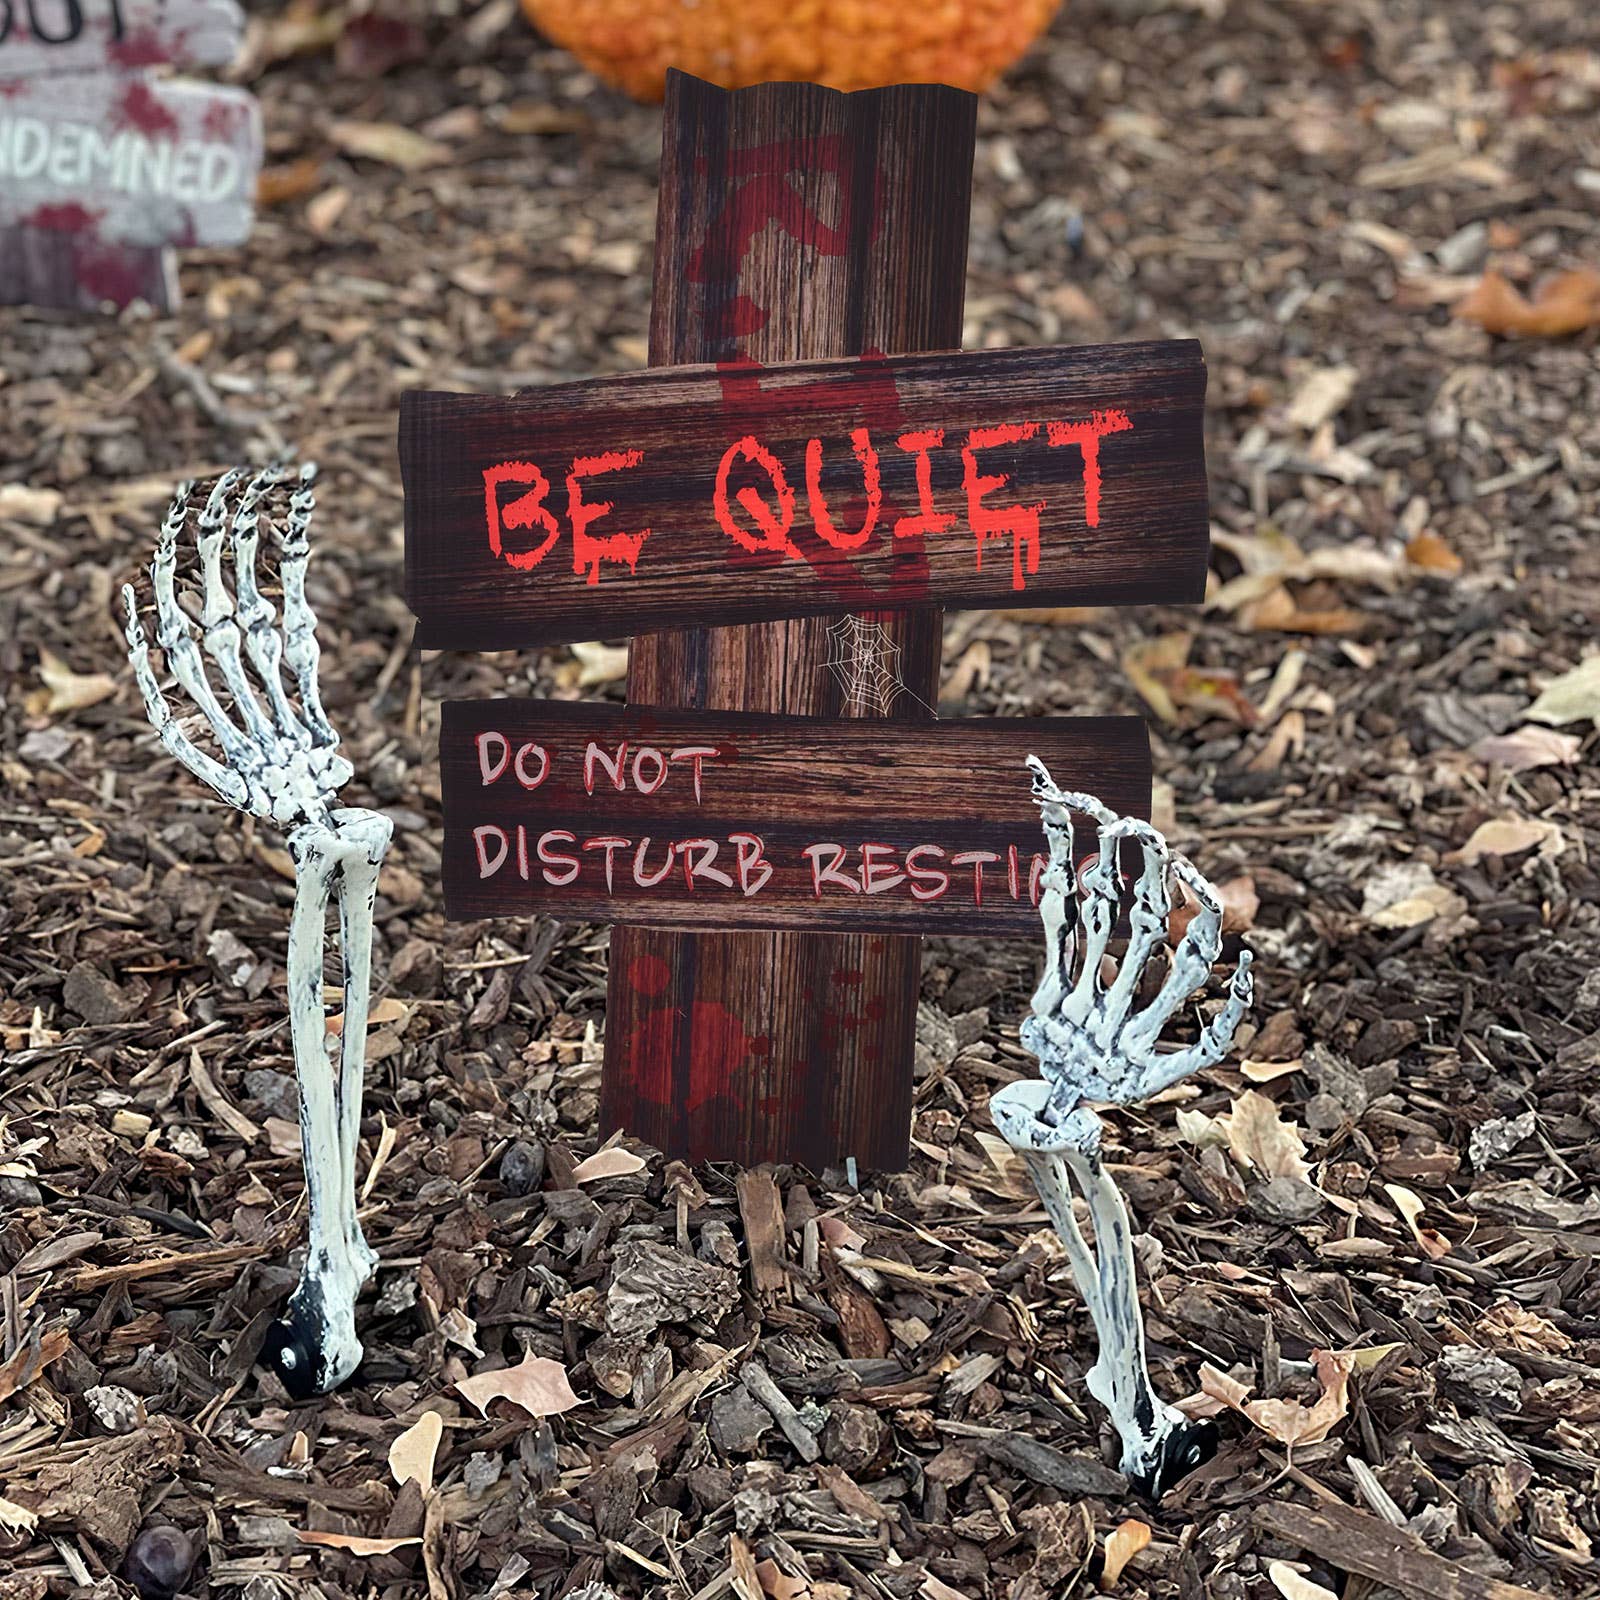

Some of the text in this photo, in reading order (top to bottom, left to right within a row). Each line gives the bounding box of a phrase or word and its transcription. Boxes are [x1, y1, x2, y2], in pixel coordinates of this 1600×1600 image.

[482, 408, 1135, 591] BE QUIET
[474, 731, 721, 806] DO NOT
[472, 824, 774, 896] DISTURB
